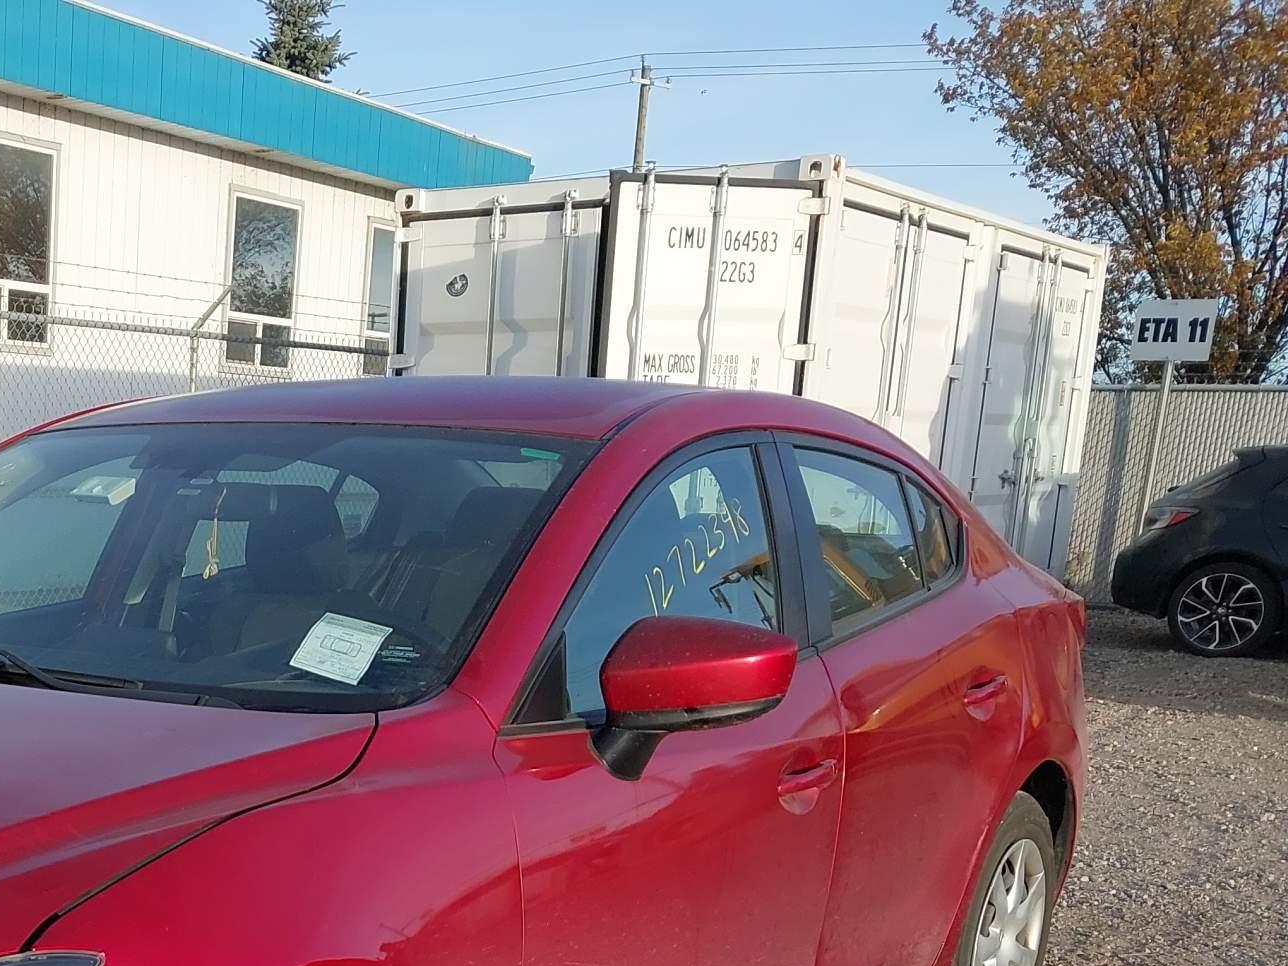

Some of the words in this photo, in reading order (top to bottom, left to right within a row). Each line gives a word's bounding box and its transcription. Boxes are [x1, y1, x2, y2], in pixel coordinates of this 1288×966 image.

[667, 226, 706, 249] CIMU
[724, 229, 778, 253] 064583
[794, 233, 804, 253] 4
[719, 260, 756, 283] 22G3
[1137, 317, 1178, 343] ETA
[1188, 317, 1210, 343] 11
[643, 353, 664, 373] MAX
[667, 354, 696, 374] GROSS
